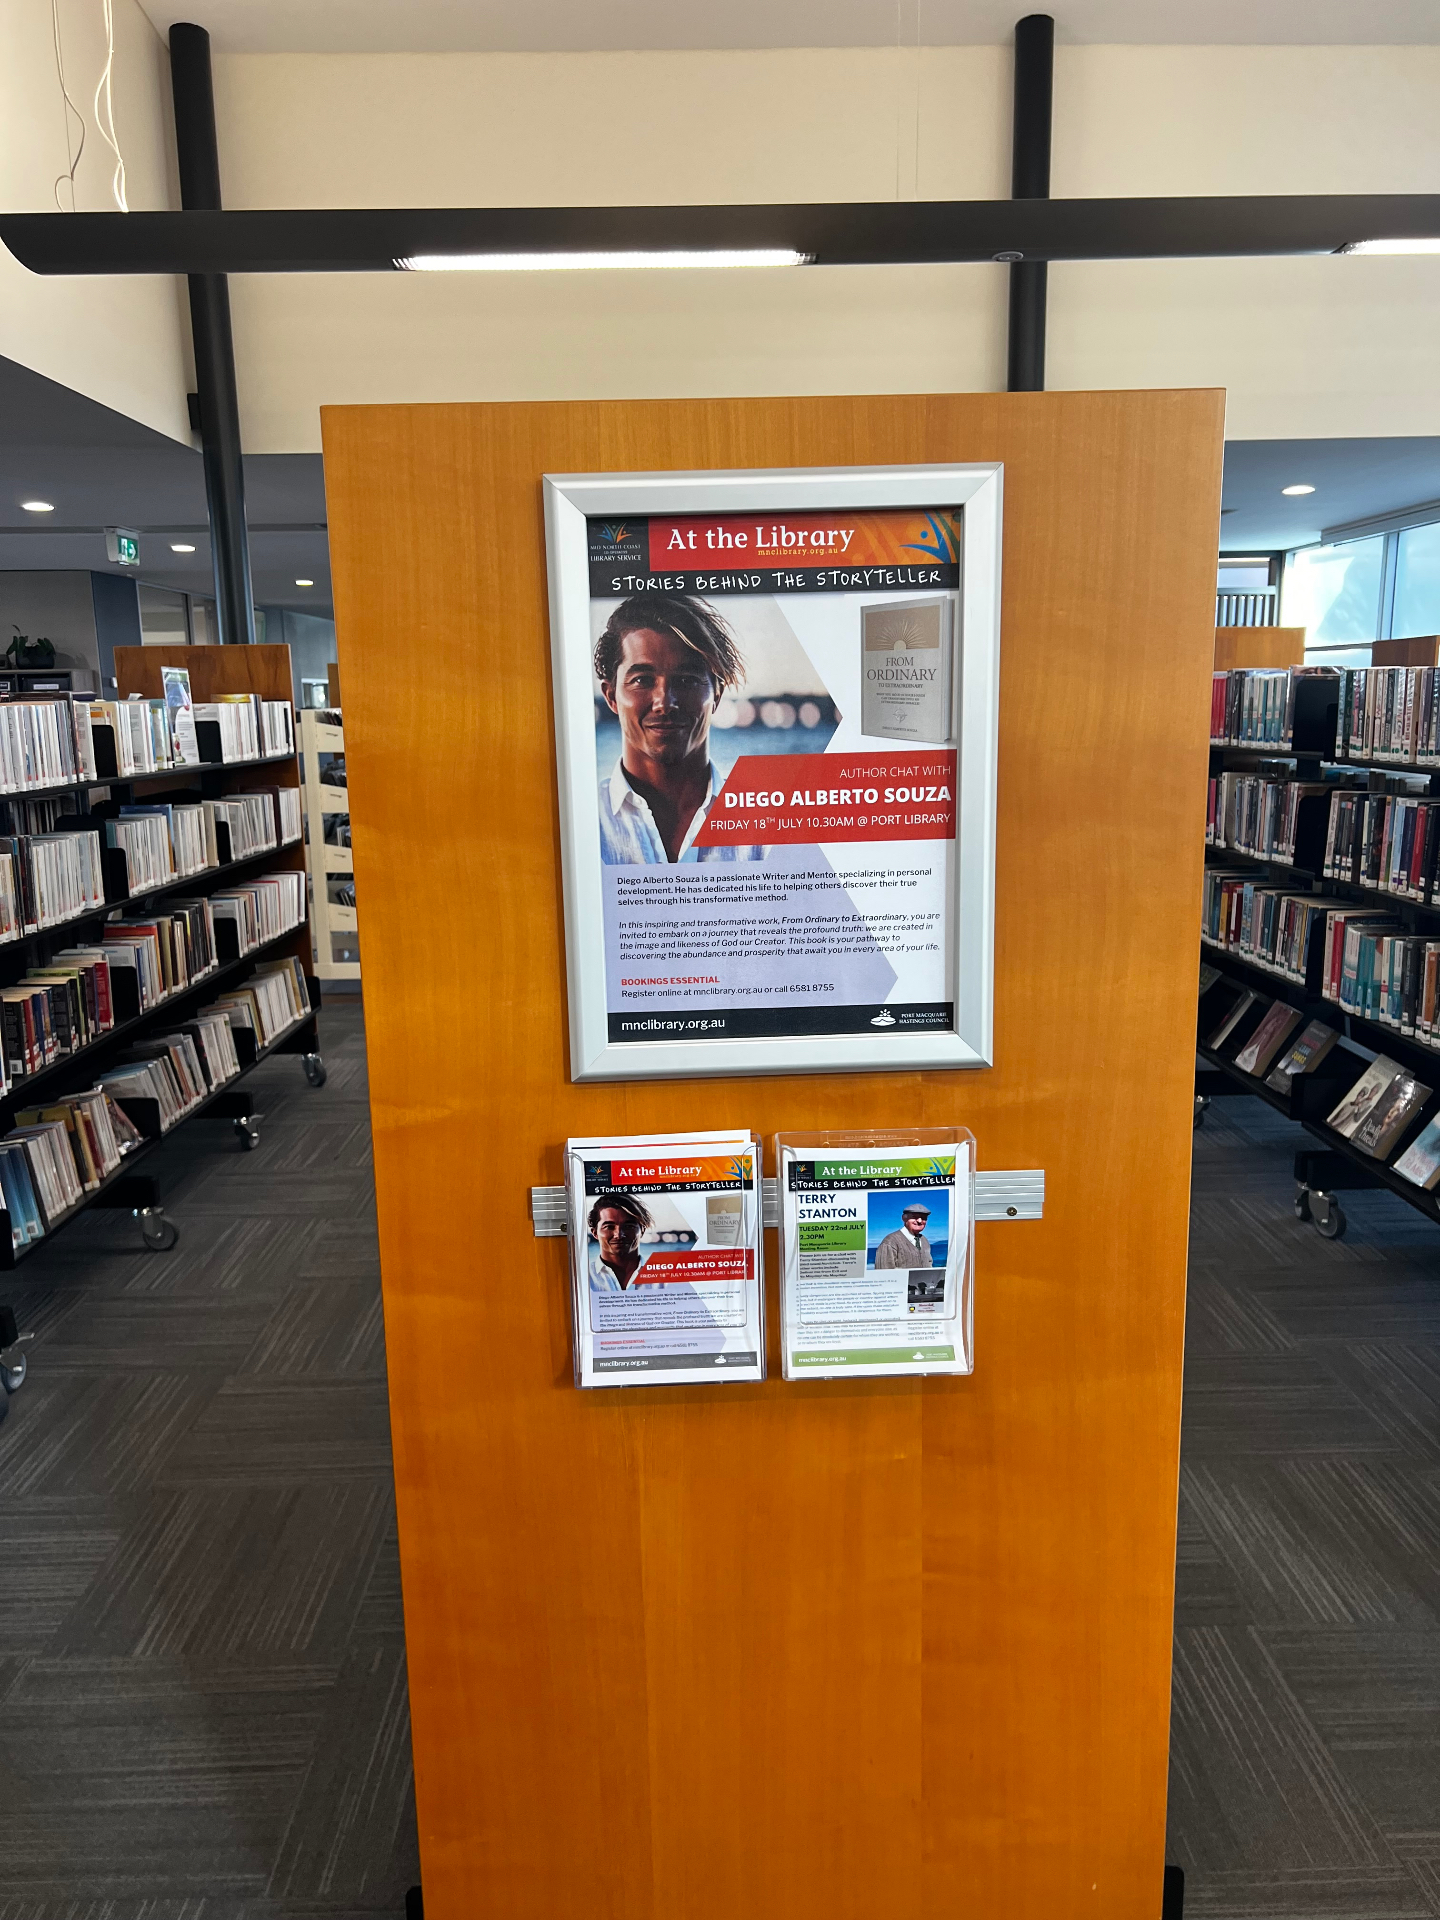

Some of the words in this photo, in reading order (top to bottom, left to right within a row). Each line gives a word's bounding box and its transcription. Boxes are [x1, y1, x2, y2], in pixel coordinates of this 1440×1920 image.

[667, 528, 697, 549] At
[706, 527, 748, 548] the
[755, 526, 854, 552] Library
[758, 548, 838, 556] mnclibrary.org.au
[612, 575, 685, 591] STORIES
[696, 574, 761, 590] BEHIND
[772, 572, 805, 588] THE
[817, 569, 941, 586] STORYTELLER
[886, 657, 914, 666] FROM
[867, 669, 936, 680] ORDINARY
[840, 768, 886, 778] AUTHOR
[890, 766, 920, 777] CHAT
[922, 766, 950, 776] WITH
[725, 792, 784, 808] DIEGO
[790, 788, 878, 806] ALBERTO
[884, 786, 951, 803] SOUZA
[710, 819, 749, 830] FRIDAY
[777, 818, 803, 830] JULY
[807, 816, 854, 828] 10.30AM
[857, 816, 868, 826] @
[872, 815, 901, 825] PORT
[904, 814, 950, 824] LIBRARY
[717, 874, 760, 883] passionate
[839, 870, 885, 879] specializing
[897, 868, 931, 877] personal
[618, 886, 673, 895] development.
[783, 882, 812, 891] helping
[646, 897, 678, 905] through
[693, 895, 753, 903] transformative
[645, 920, 679, 929] inspiring
[697, 918, 756, 926] transformative
[805, 916, 840, 924] Ordinary
[852, 914, 909, 922] Extraordinary,
[708, 929, 738, 938] journey
[803, 926, 840, 934] profound
[635, 942, 659, 950] image
[856, 935, 890, 943] pathway
[620, 952, 666, 960] discovering
[683, 950, 726, 958] abundance
[744, 948, 785, 957] prosperity
[622, 990, 656, 998] Register
[694, 987, 762, 996] mnclibrary.org.au
[622, 1019, 725, 1031] mnclibrary.org.au
[619, 1168, 633, 1177] At
[637, 1167, 655, 1176] the
[658, 1166, 702, 1176] Library
[822, 1166, 835, 1175] At
[838, 1166, 857, 1175] the
[860, 1165, 902, 1175] Library
[798, 1194, 836, 1204] TERRY
[799, 1208, 857, 1219] STANTON
